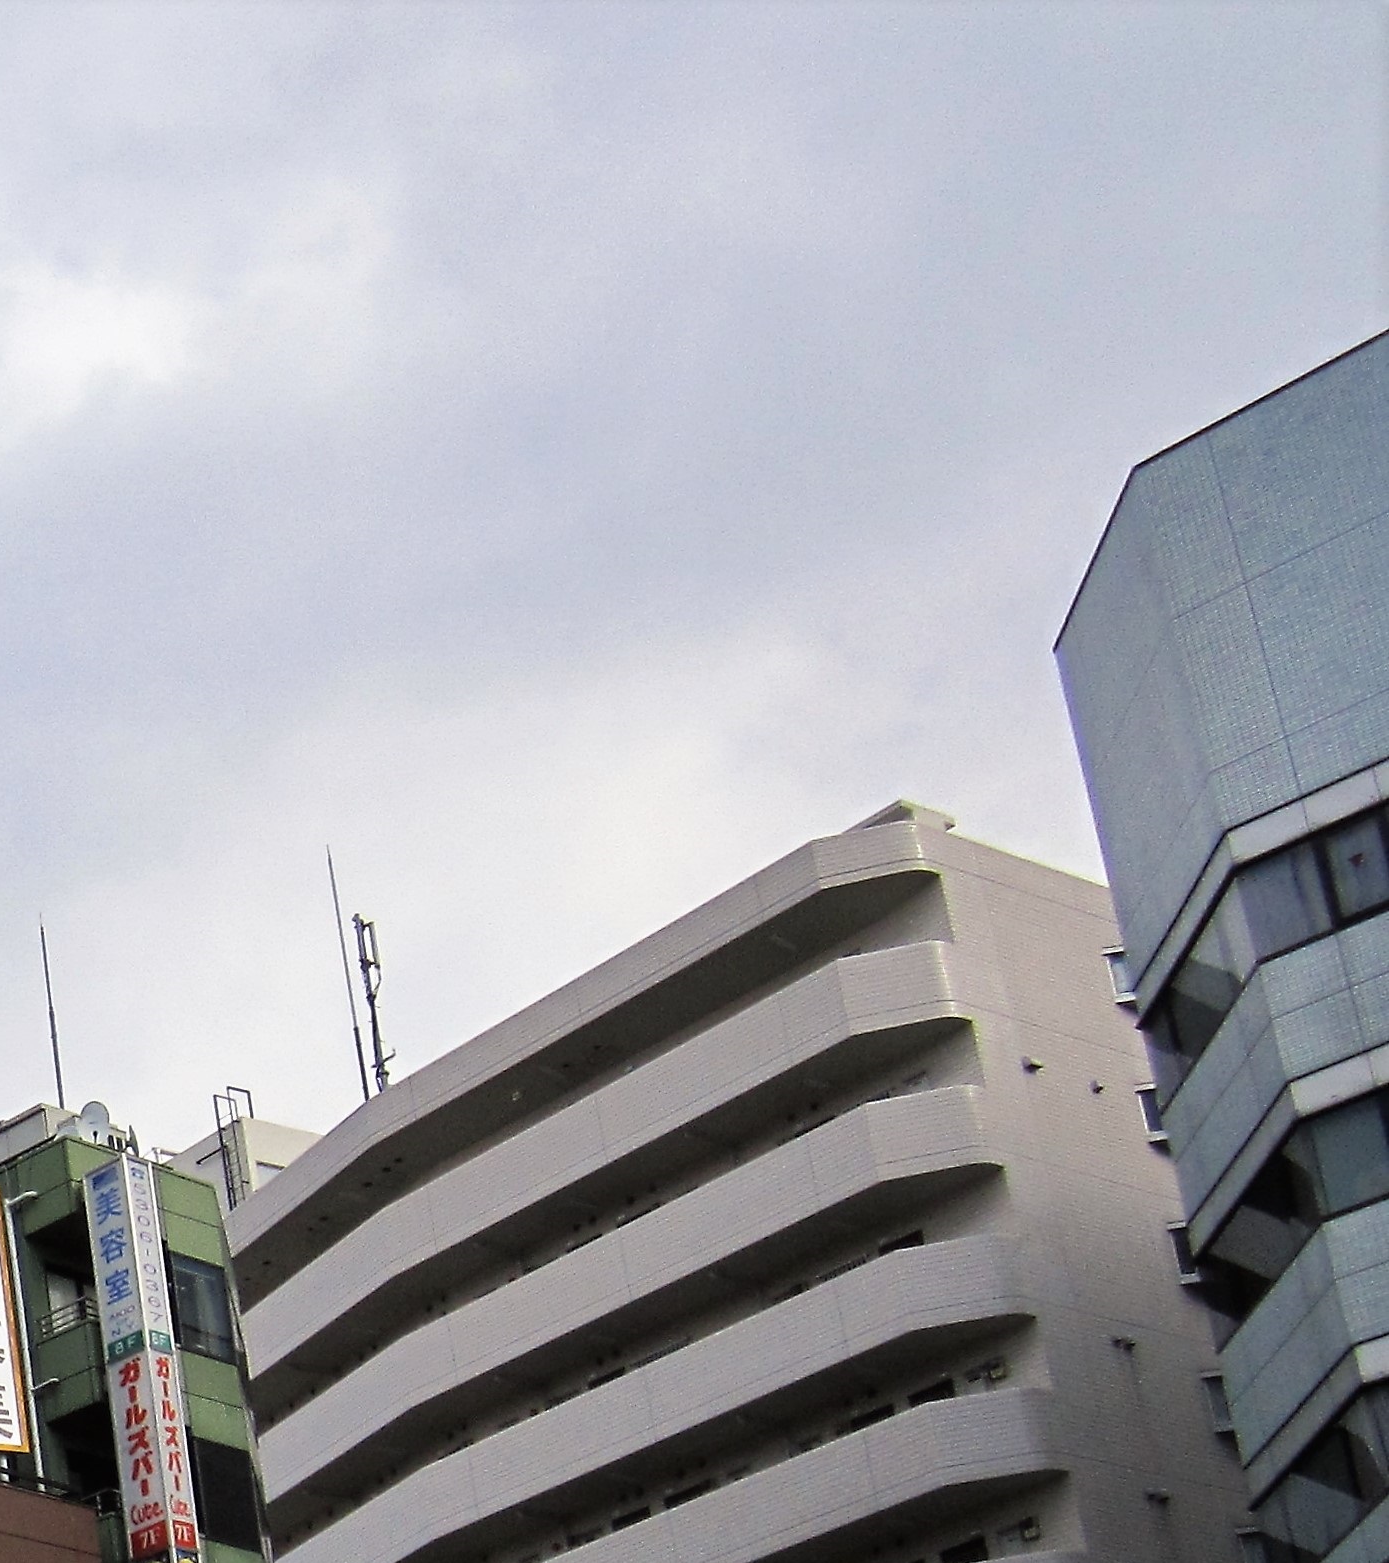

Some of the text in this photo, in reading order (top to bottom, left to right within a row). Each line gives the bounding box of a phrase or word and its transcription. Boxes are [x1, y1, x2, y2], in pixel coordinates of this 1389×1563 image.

[94, 1187, 133, 1306] 美容室
[118, 1356, 154, 1497] ガールズバー
[155, 1356, 182, 1492] ガールズバー
[140, 1533, 160, 1549] 7F
[174, 1524, 191, 1541] 7F
